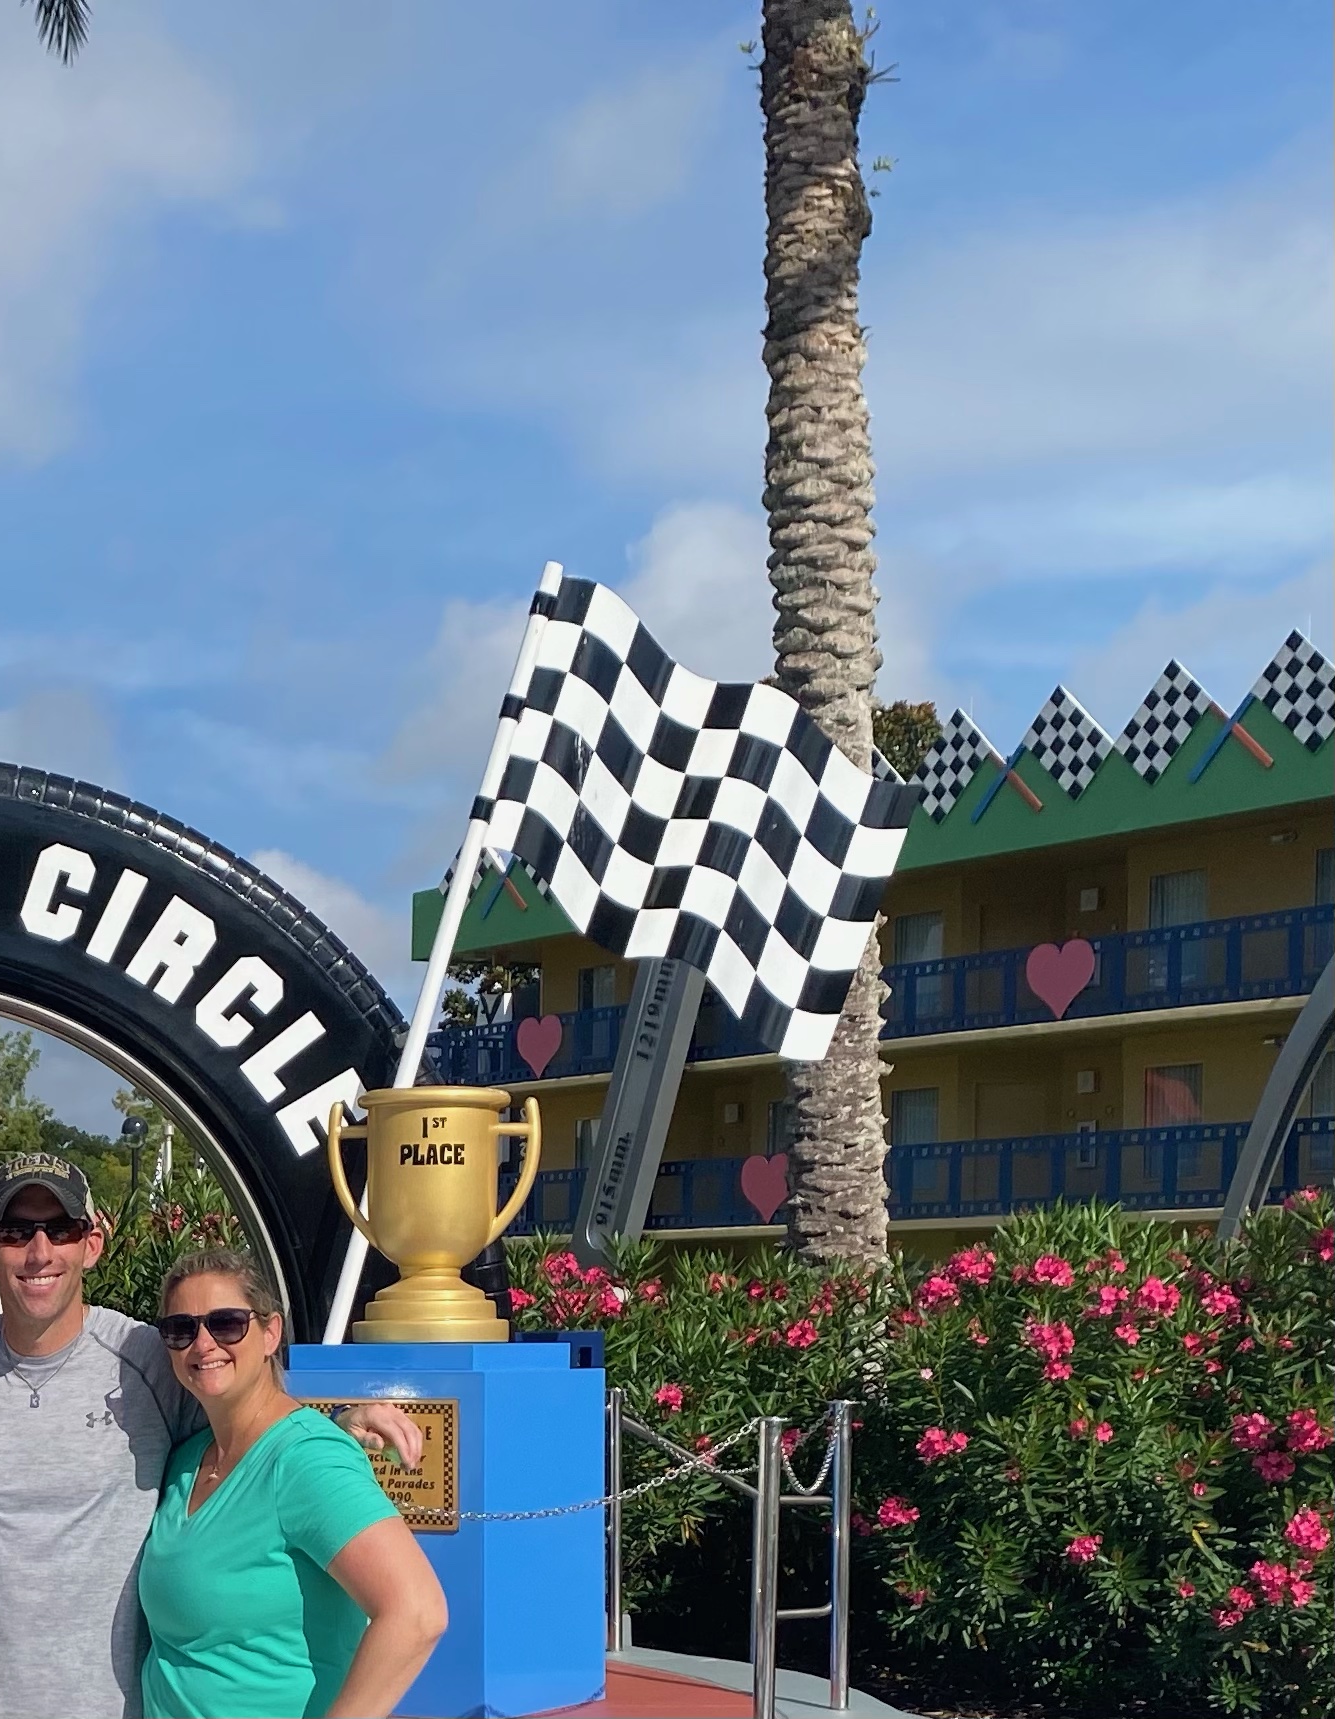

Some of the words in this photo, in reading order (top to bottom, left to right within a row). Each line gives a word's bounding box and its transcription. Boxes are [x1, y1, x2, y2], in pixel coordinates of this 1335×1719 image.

[19, 842, 367, 1157] CIRCLE
[400, 1143, 465, 1166] PLACE
[387, 1478, 435, 1490] Parades
[385, 1491, 415, 1503] 990.
